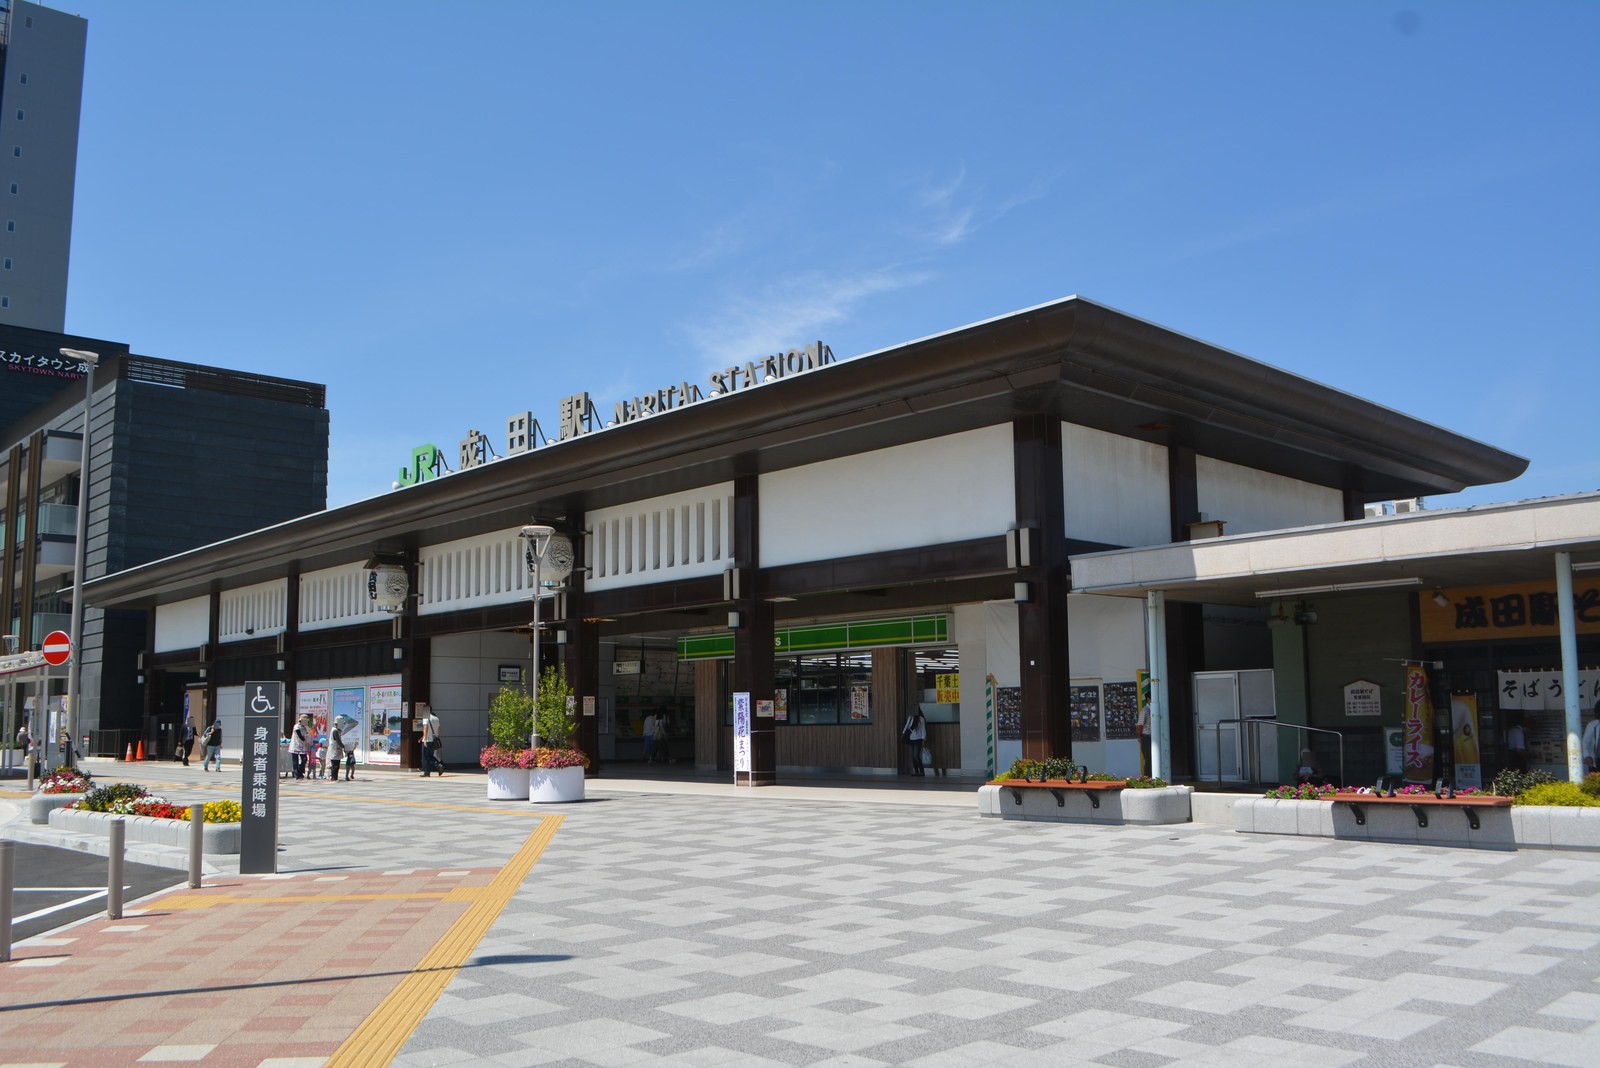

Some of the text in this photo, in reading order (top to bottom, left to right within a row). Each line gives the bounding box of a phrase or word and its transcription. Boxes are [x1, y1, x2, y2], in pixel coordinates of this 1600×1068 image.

[0, 350, 99, 373] スカイタウン成
[8, 363, 85, 379] SKYTOWN NARIT
[400, 443, 437, 487] JR
[614, 381, 691, 425] NARITA
[709, 340, 822, 394] STATION
[737, 698, 746, 768] 紫陽花まつり
[1406, 671, 1426, 768] カレーライス
[251, 726, 269, 818] 身障者乗降場
